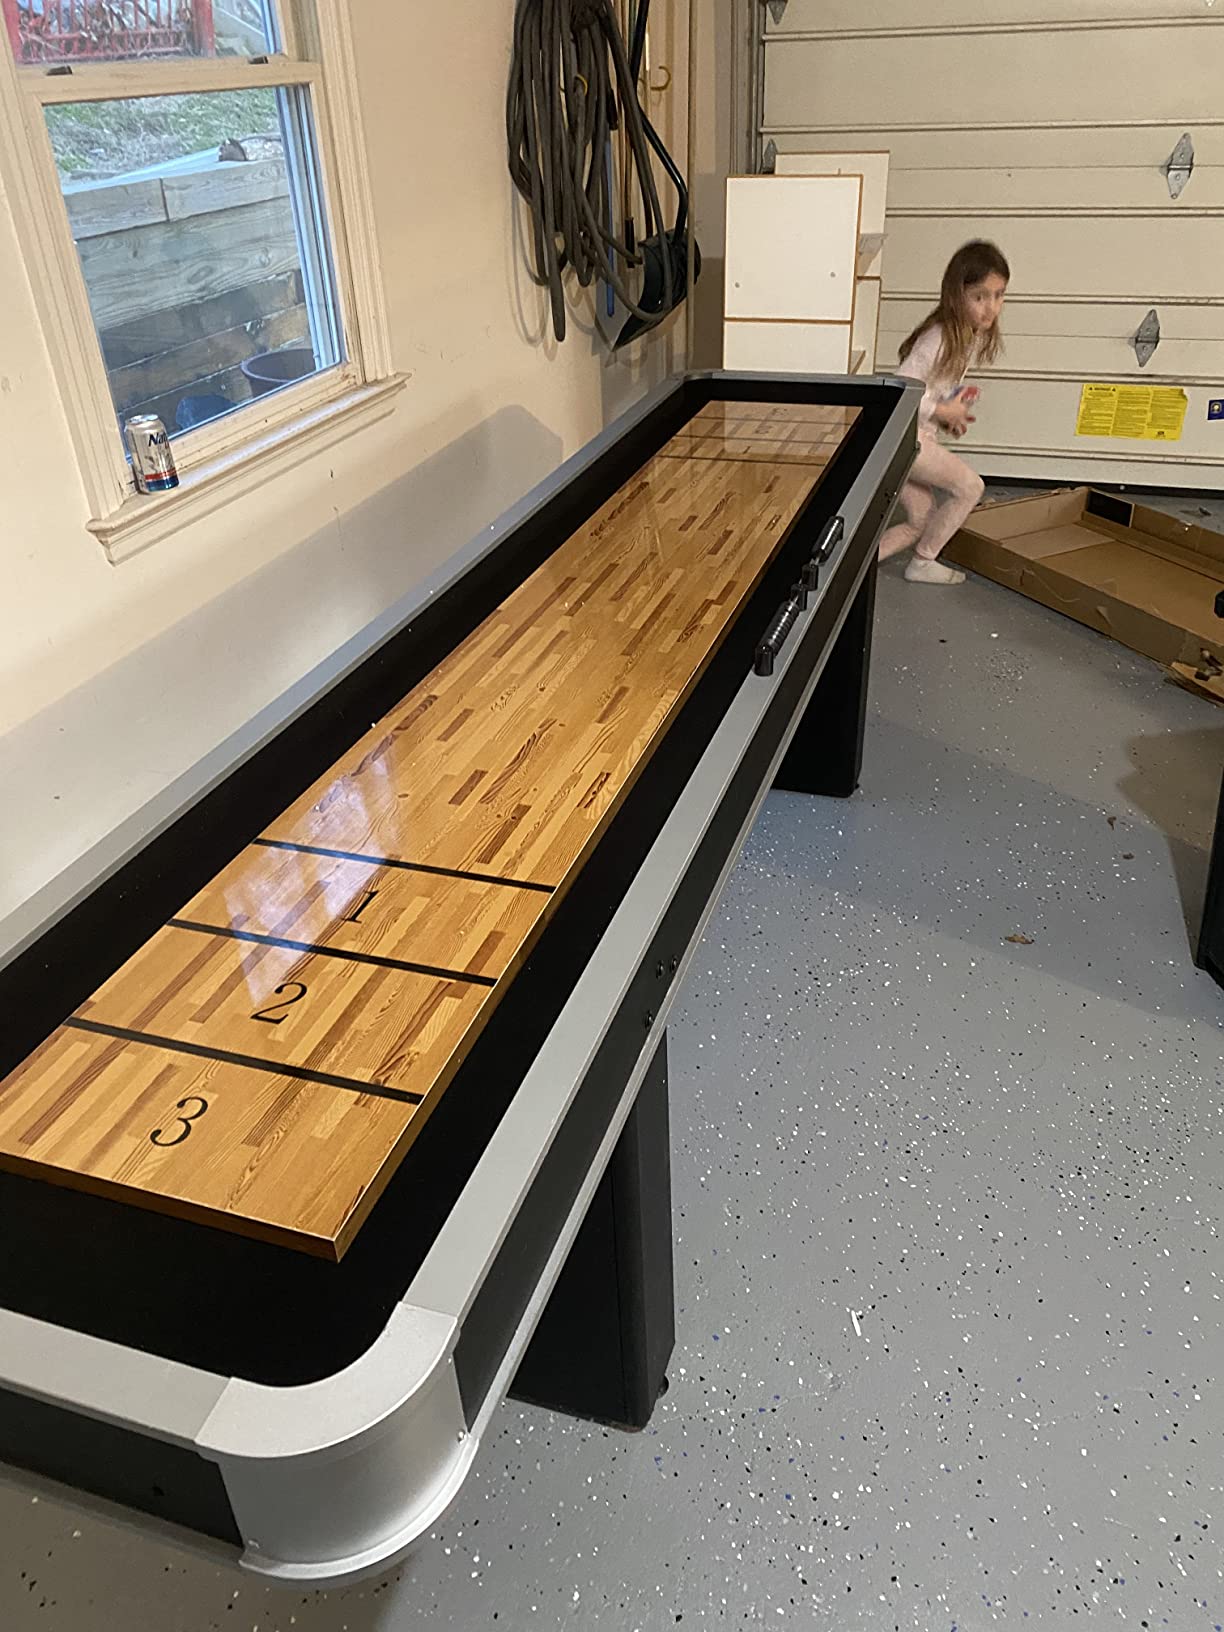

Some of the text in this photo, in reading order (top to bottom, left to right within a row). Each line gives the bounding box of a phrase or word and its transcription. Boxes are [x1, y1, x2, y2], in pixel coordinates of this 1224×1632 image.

[341, 890, 379, 924] 1
[250, 982, 308, 1025] 2
[150, 1096, 209, 1147] 3
